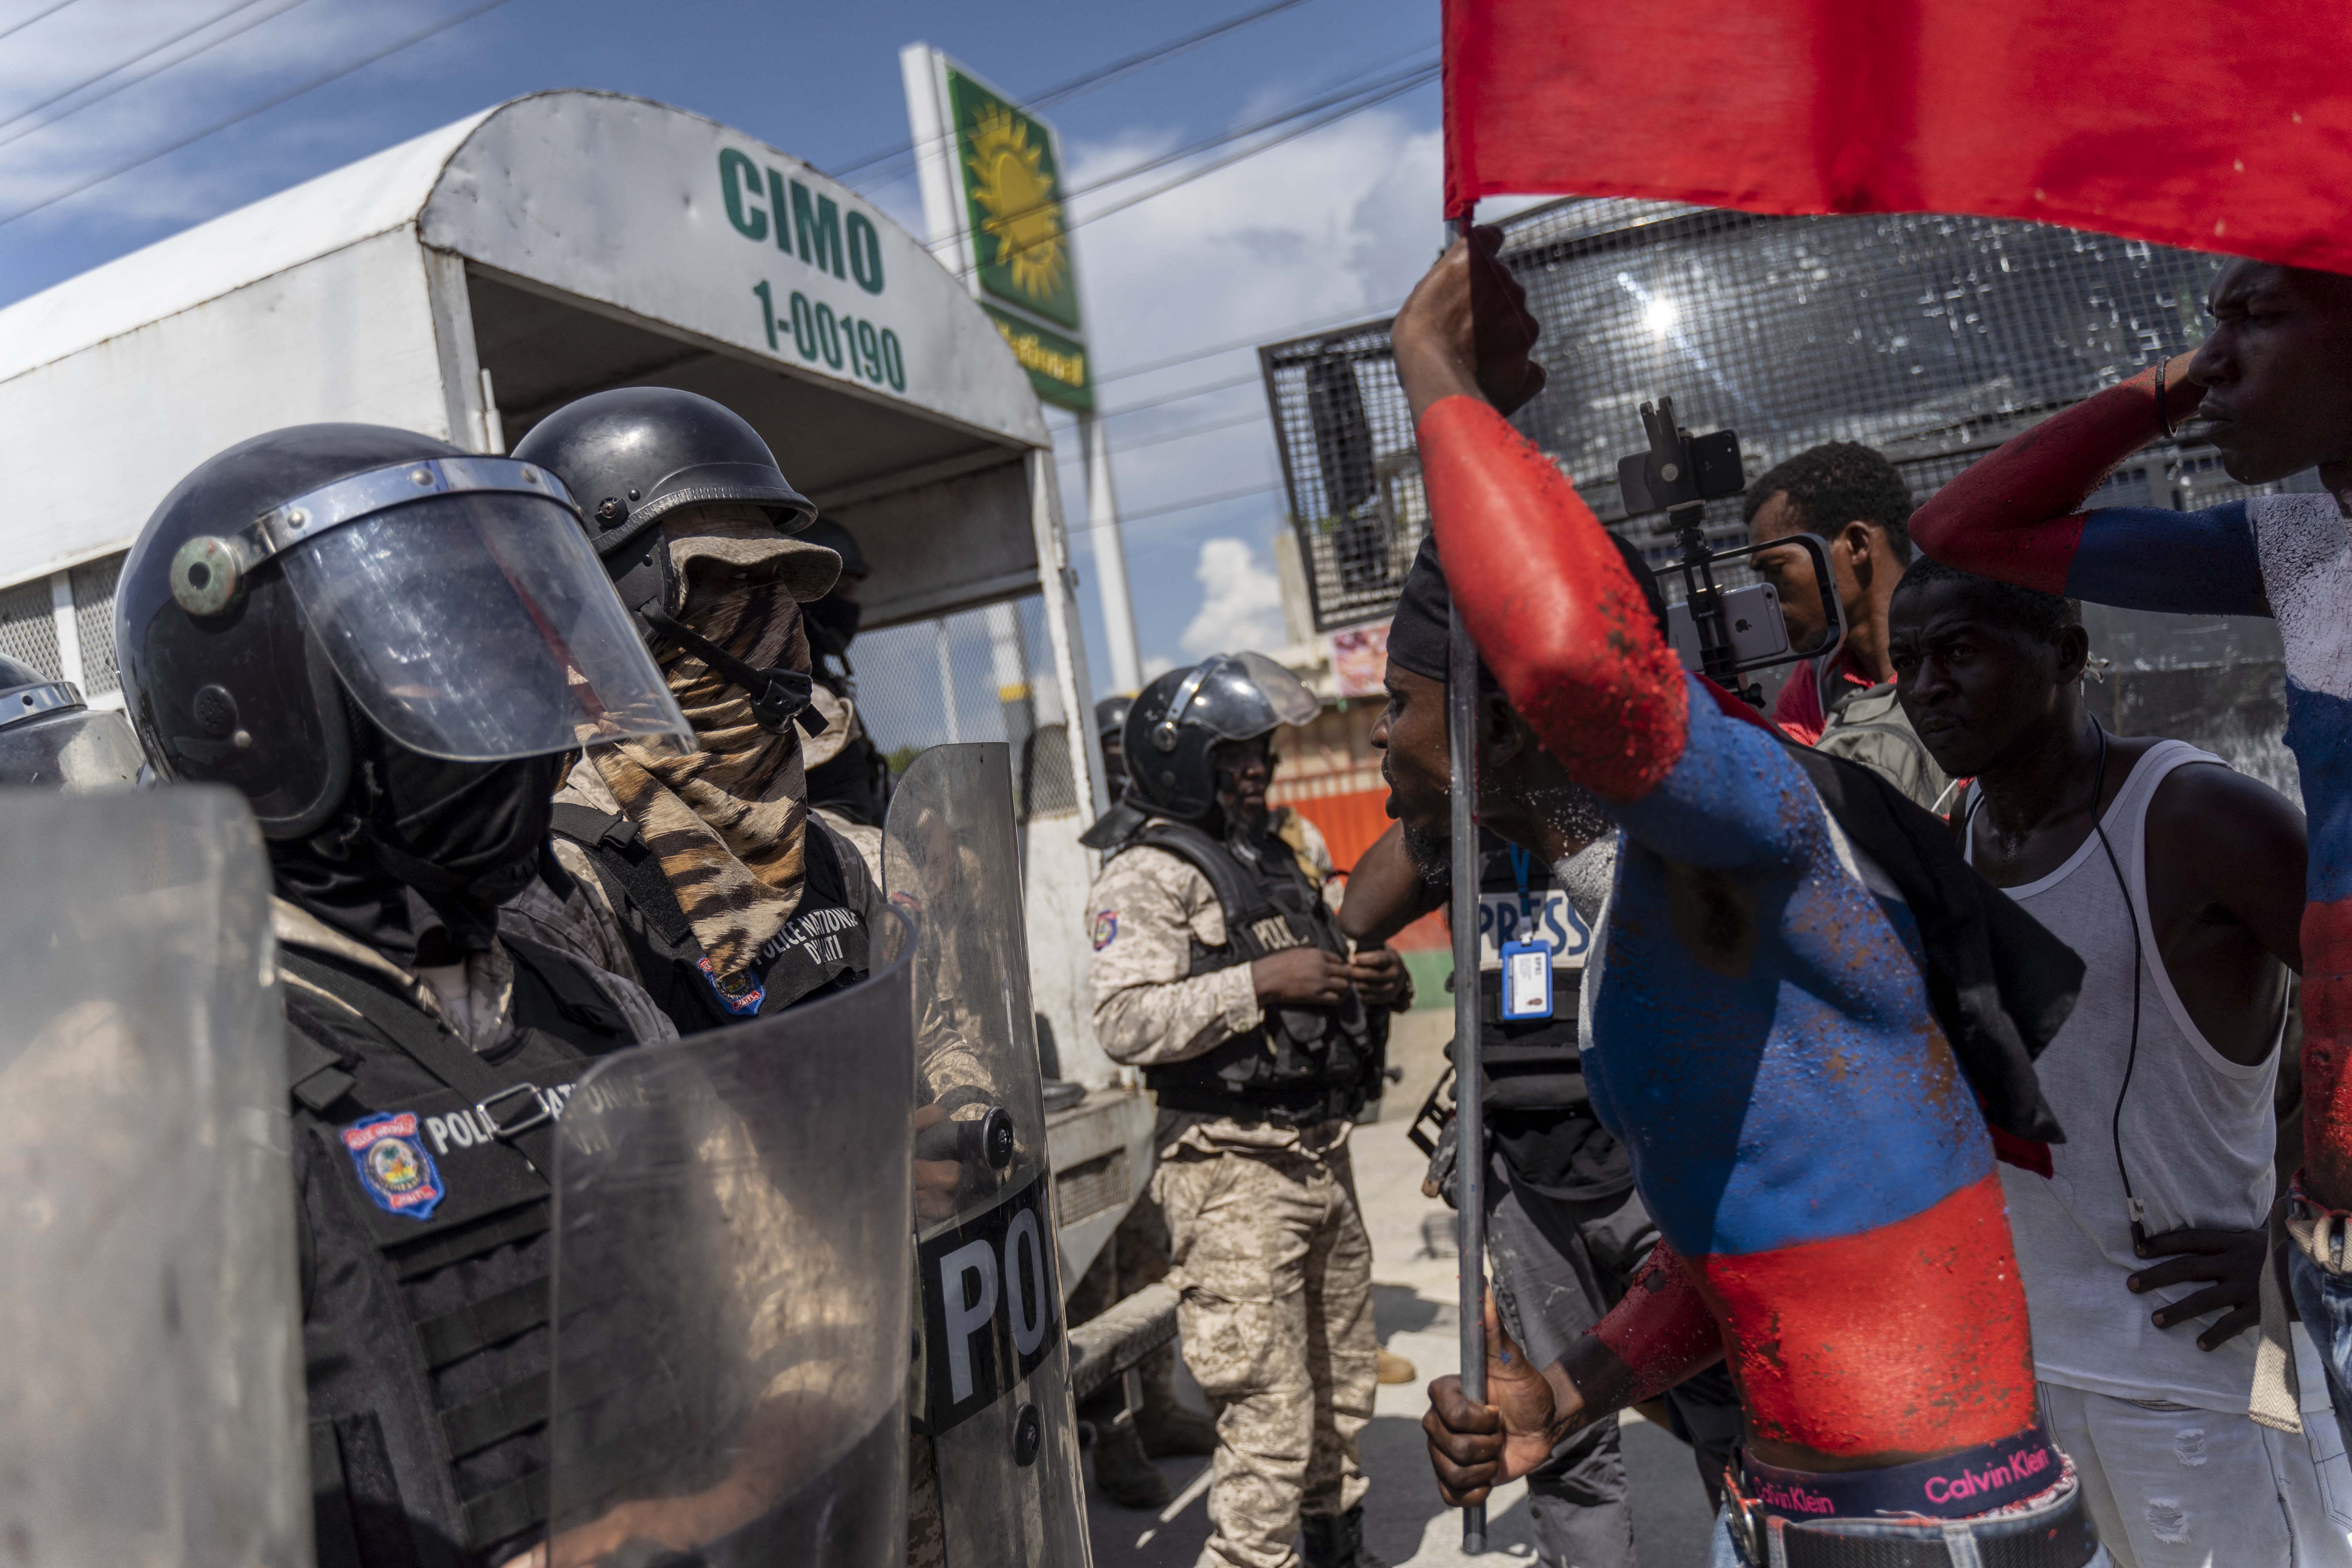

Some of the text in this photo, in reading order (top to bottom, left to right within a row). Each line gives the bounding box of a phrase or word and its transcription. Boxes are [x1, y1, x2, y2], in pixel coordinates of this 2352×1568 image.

[719, 147, 884, 296] CIMO
[753, 279, 906, 394] 1-00190
[756, 921, 807, 965] OLICE
[1252, 915, 1310, 951] POLI
[426, 1109, 495, 1156] POLI
[1753, 1476, 1836, 1514] Calvin Klein
[1924, 1444, 2049, 1504] Calvin Klein
